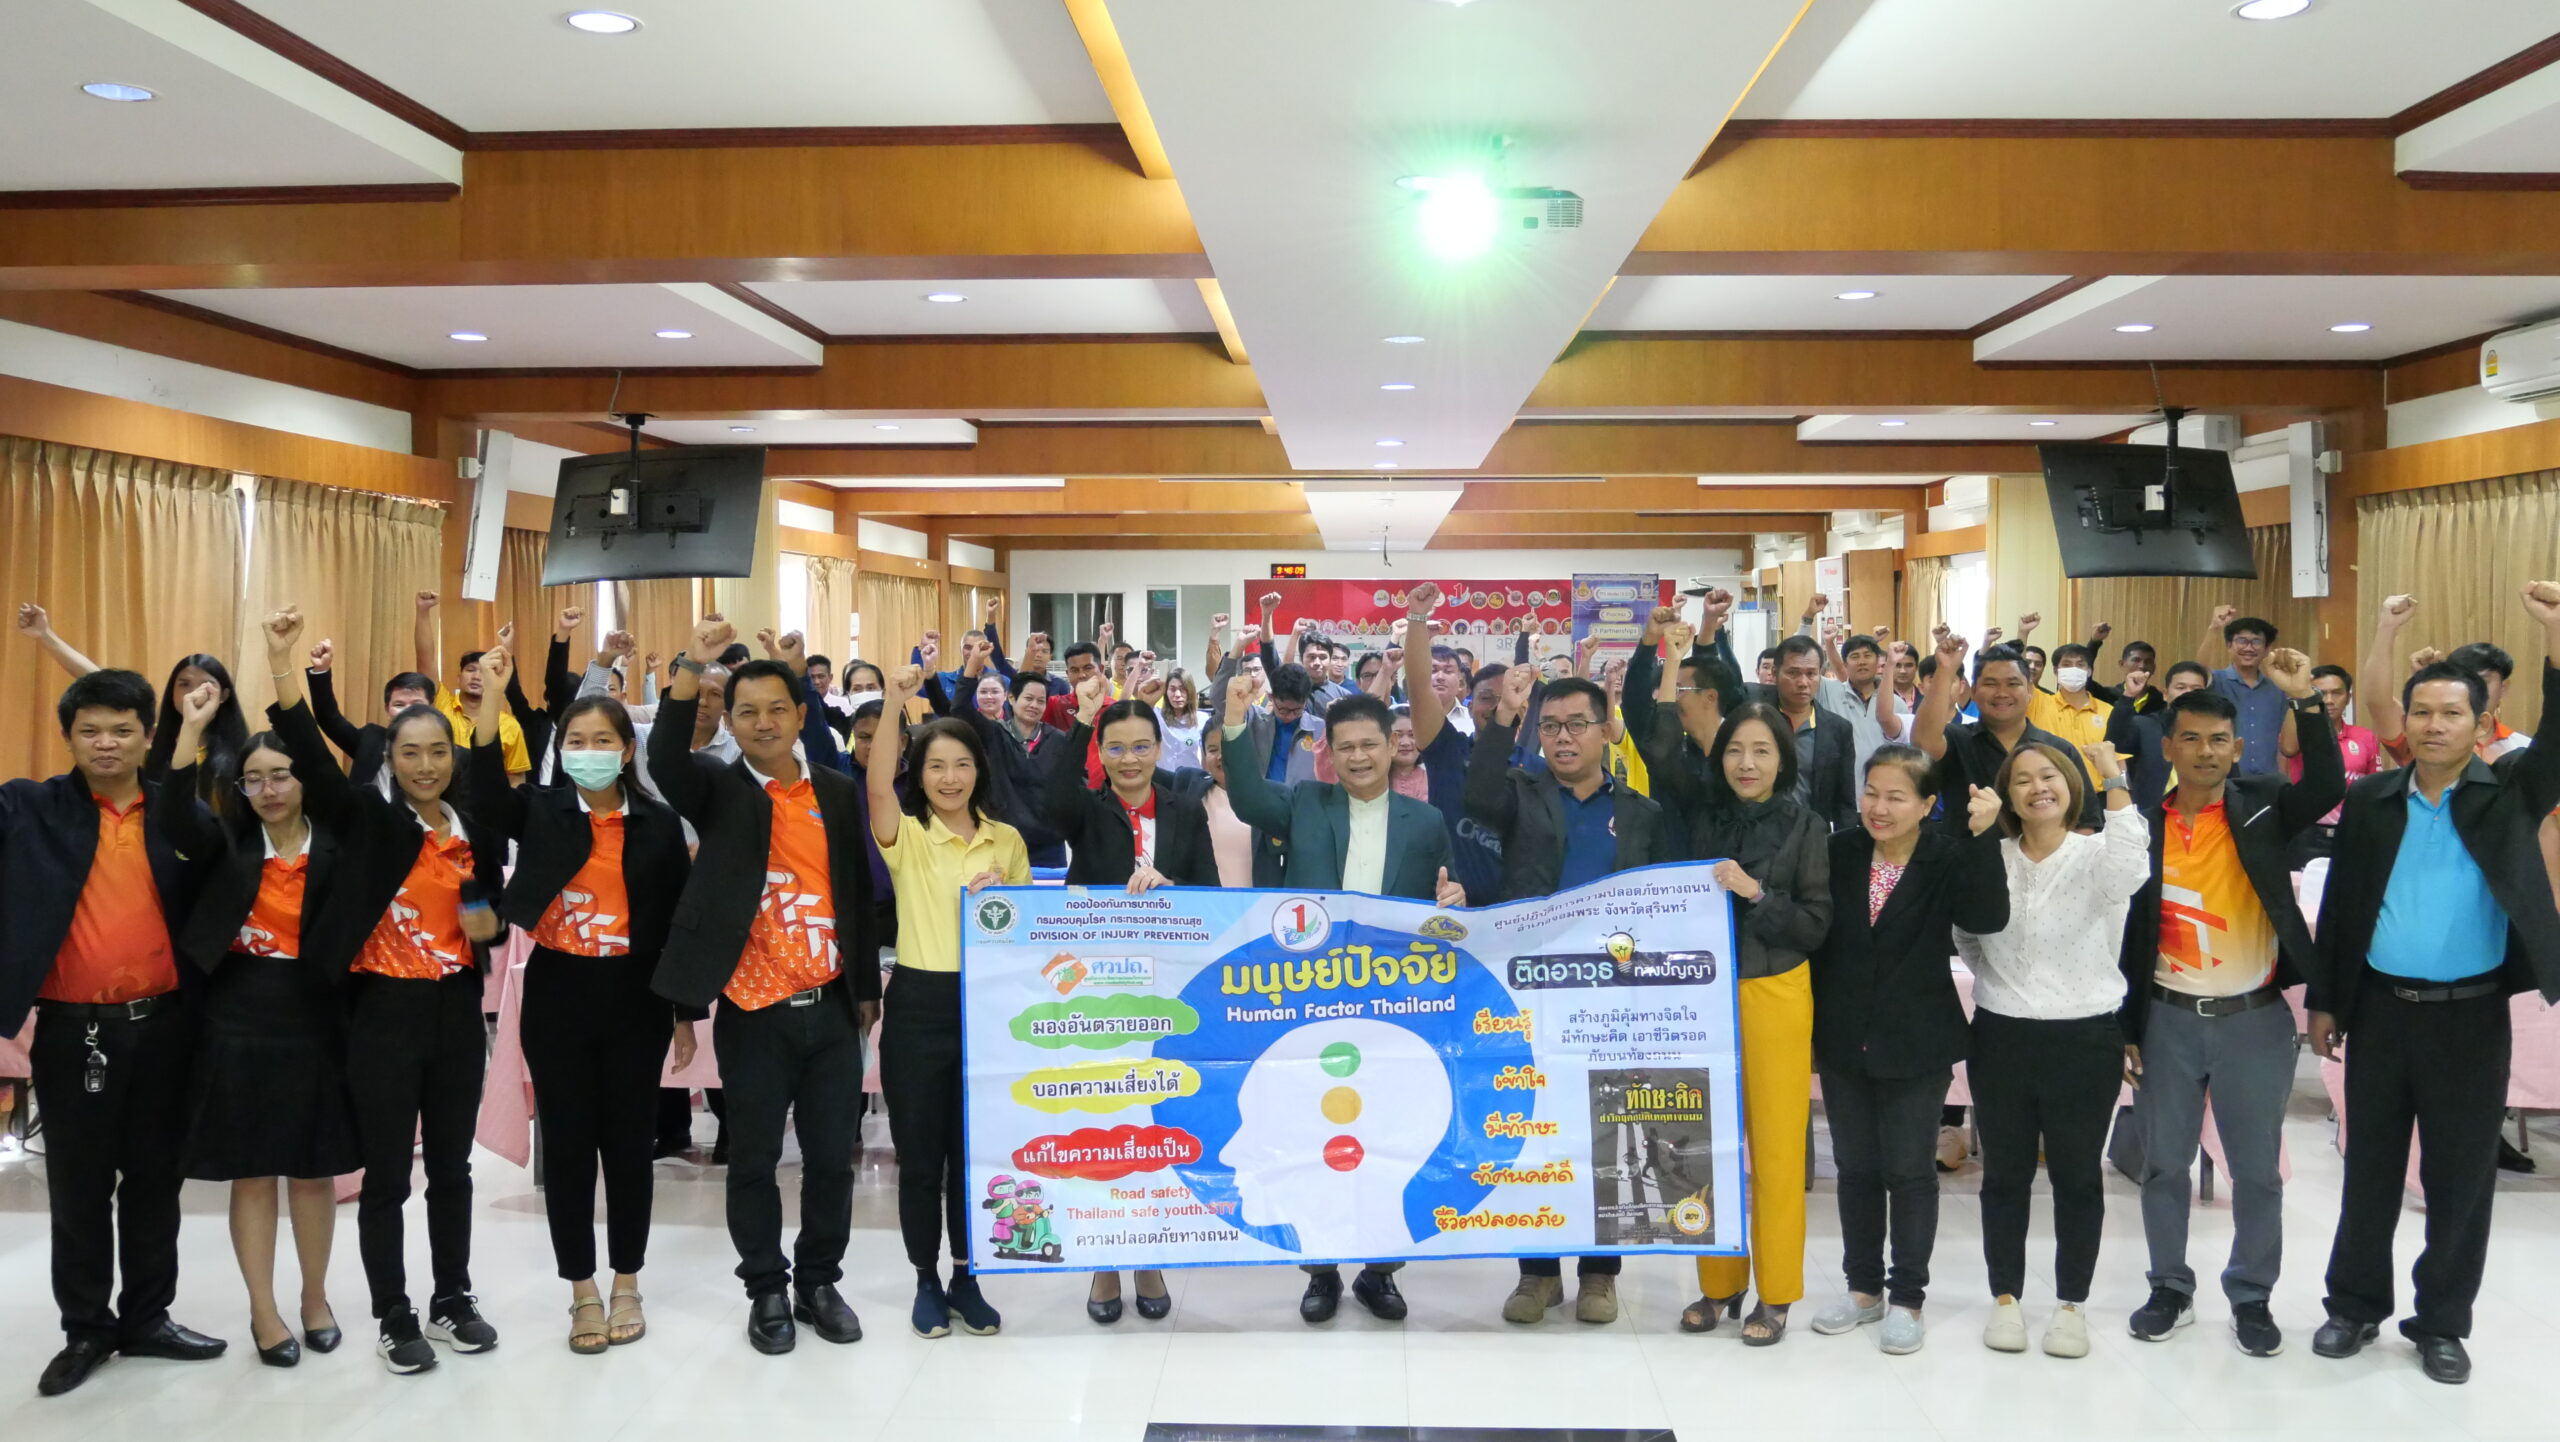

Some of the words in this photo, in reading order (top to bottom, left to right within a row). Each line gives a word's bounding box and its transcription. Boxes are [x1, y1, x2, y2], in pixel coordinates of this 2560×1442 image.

[1066, 898, 1171, 909] กองป้องกันการบาดเจ็บ
[1605, 899, 1687, 919] จังหวัดสุรินทร์
[1036, 913, 1106, 927] กรมควบคุมโรค
[1110, 915, 1202, 927] กระทรวงสาธารณสุข
[1030, 931, 1078, 940] DIVISION
[1083, 931, 1097, 940] OF
[1101, 931, 1139, 939] INJURY
[1144, 931, 1209, 941] PREVENTION
[1220, 941, 1457, 1006] มนุษย์ปัจจัย
[1515, 960, 1613, 987] ติดอาวุธ
[1226, 1006, 1297, 1022] Human
[1305, 1002, 1364, 1018] Factor
[1370, 995, 1456, 1014] Thailand
[1032, 1014, 1171, 1035] มองอันตรายออก
[1561, 1029, 1628, 1044] มีทักษะคิด
[1632, 1027, 1707, 1042] เอาชีวิตรอด
[1032, 1069, 1181, 1096] บอกความเสี่ยงได้
[1485, 1113, 1557, 1137] มีทักษะ
[1023, 1135, 1190, 1162] แก้ไขความเสี่ยงเป็น
[1110, 1188, 1145, 1200] Road
[1151, 1186, 1192, 1199] safety
[1067, 1207, 1125, 1220] Thailand
[1131, 1206, 1159, 1218] safe
[1434, 1207, 1565, 1230] ชีวิตปลอดภัย
[1076, 1227, 1239, 1247] ความปลอดภัยทางถนน
